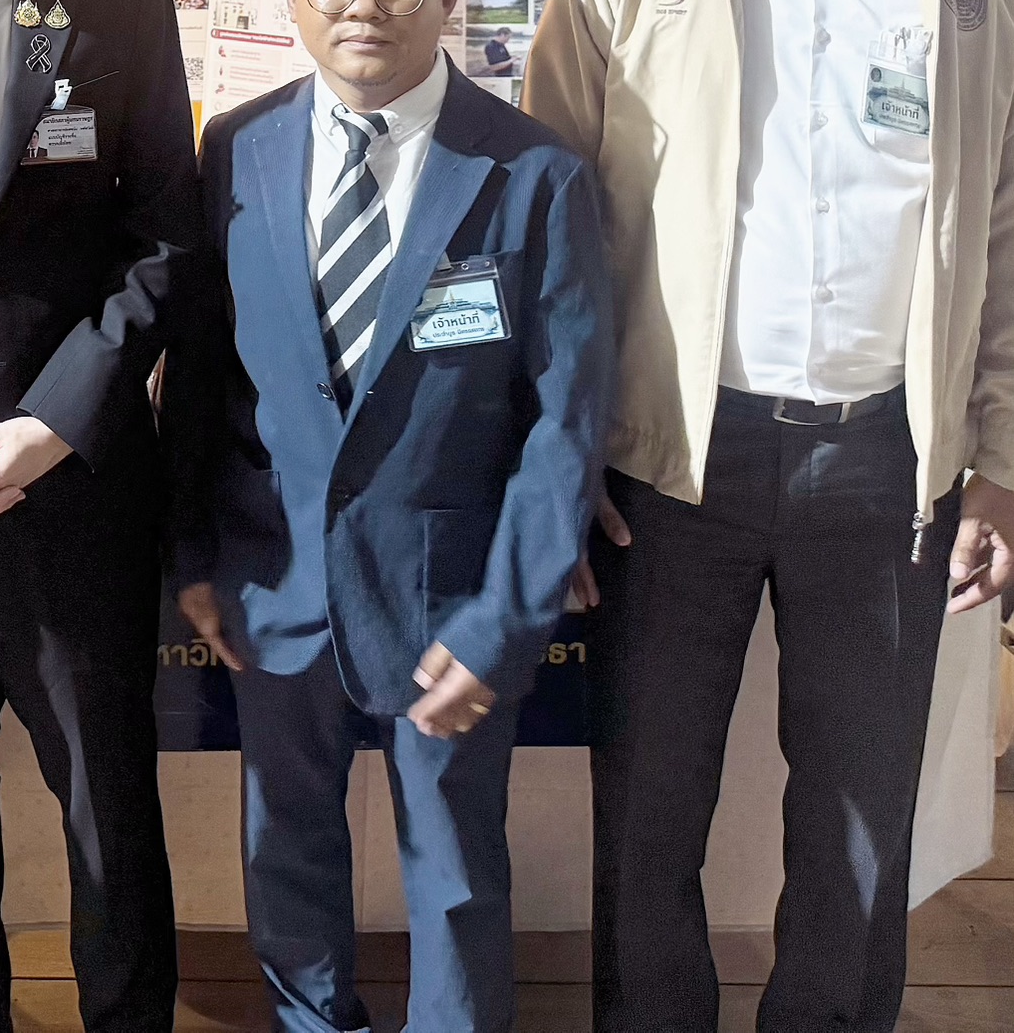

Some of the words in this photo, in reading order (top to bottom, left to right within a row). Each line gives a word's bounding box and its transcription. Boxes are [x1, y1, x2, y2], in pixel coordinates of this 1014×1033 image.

[432, 310, 481, 329] เจ้าหน้าที่
